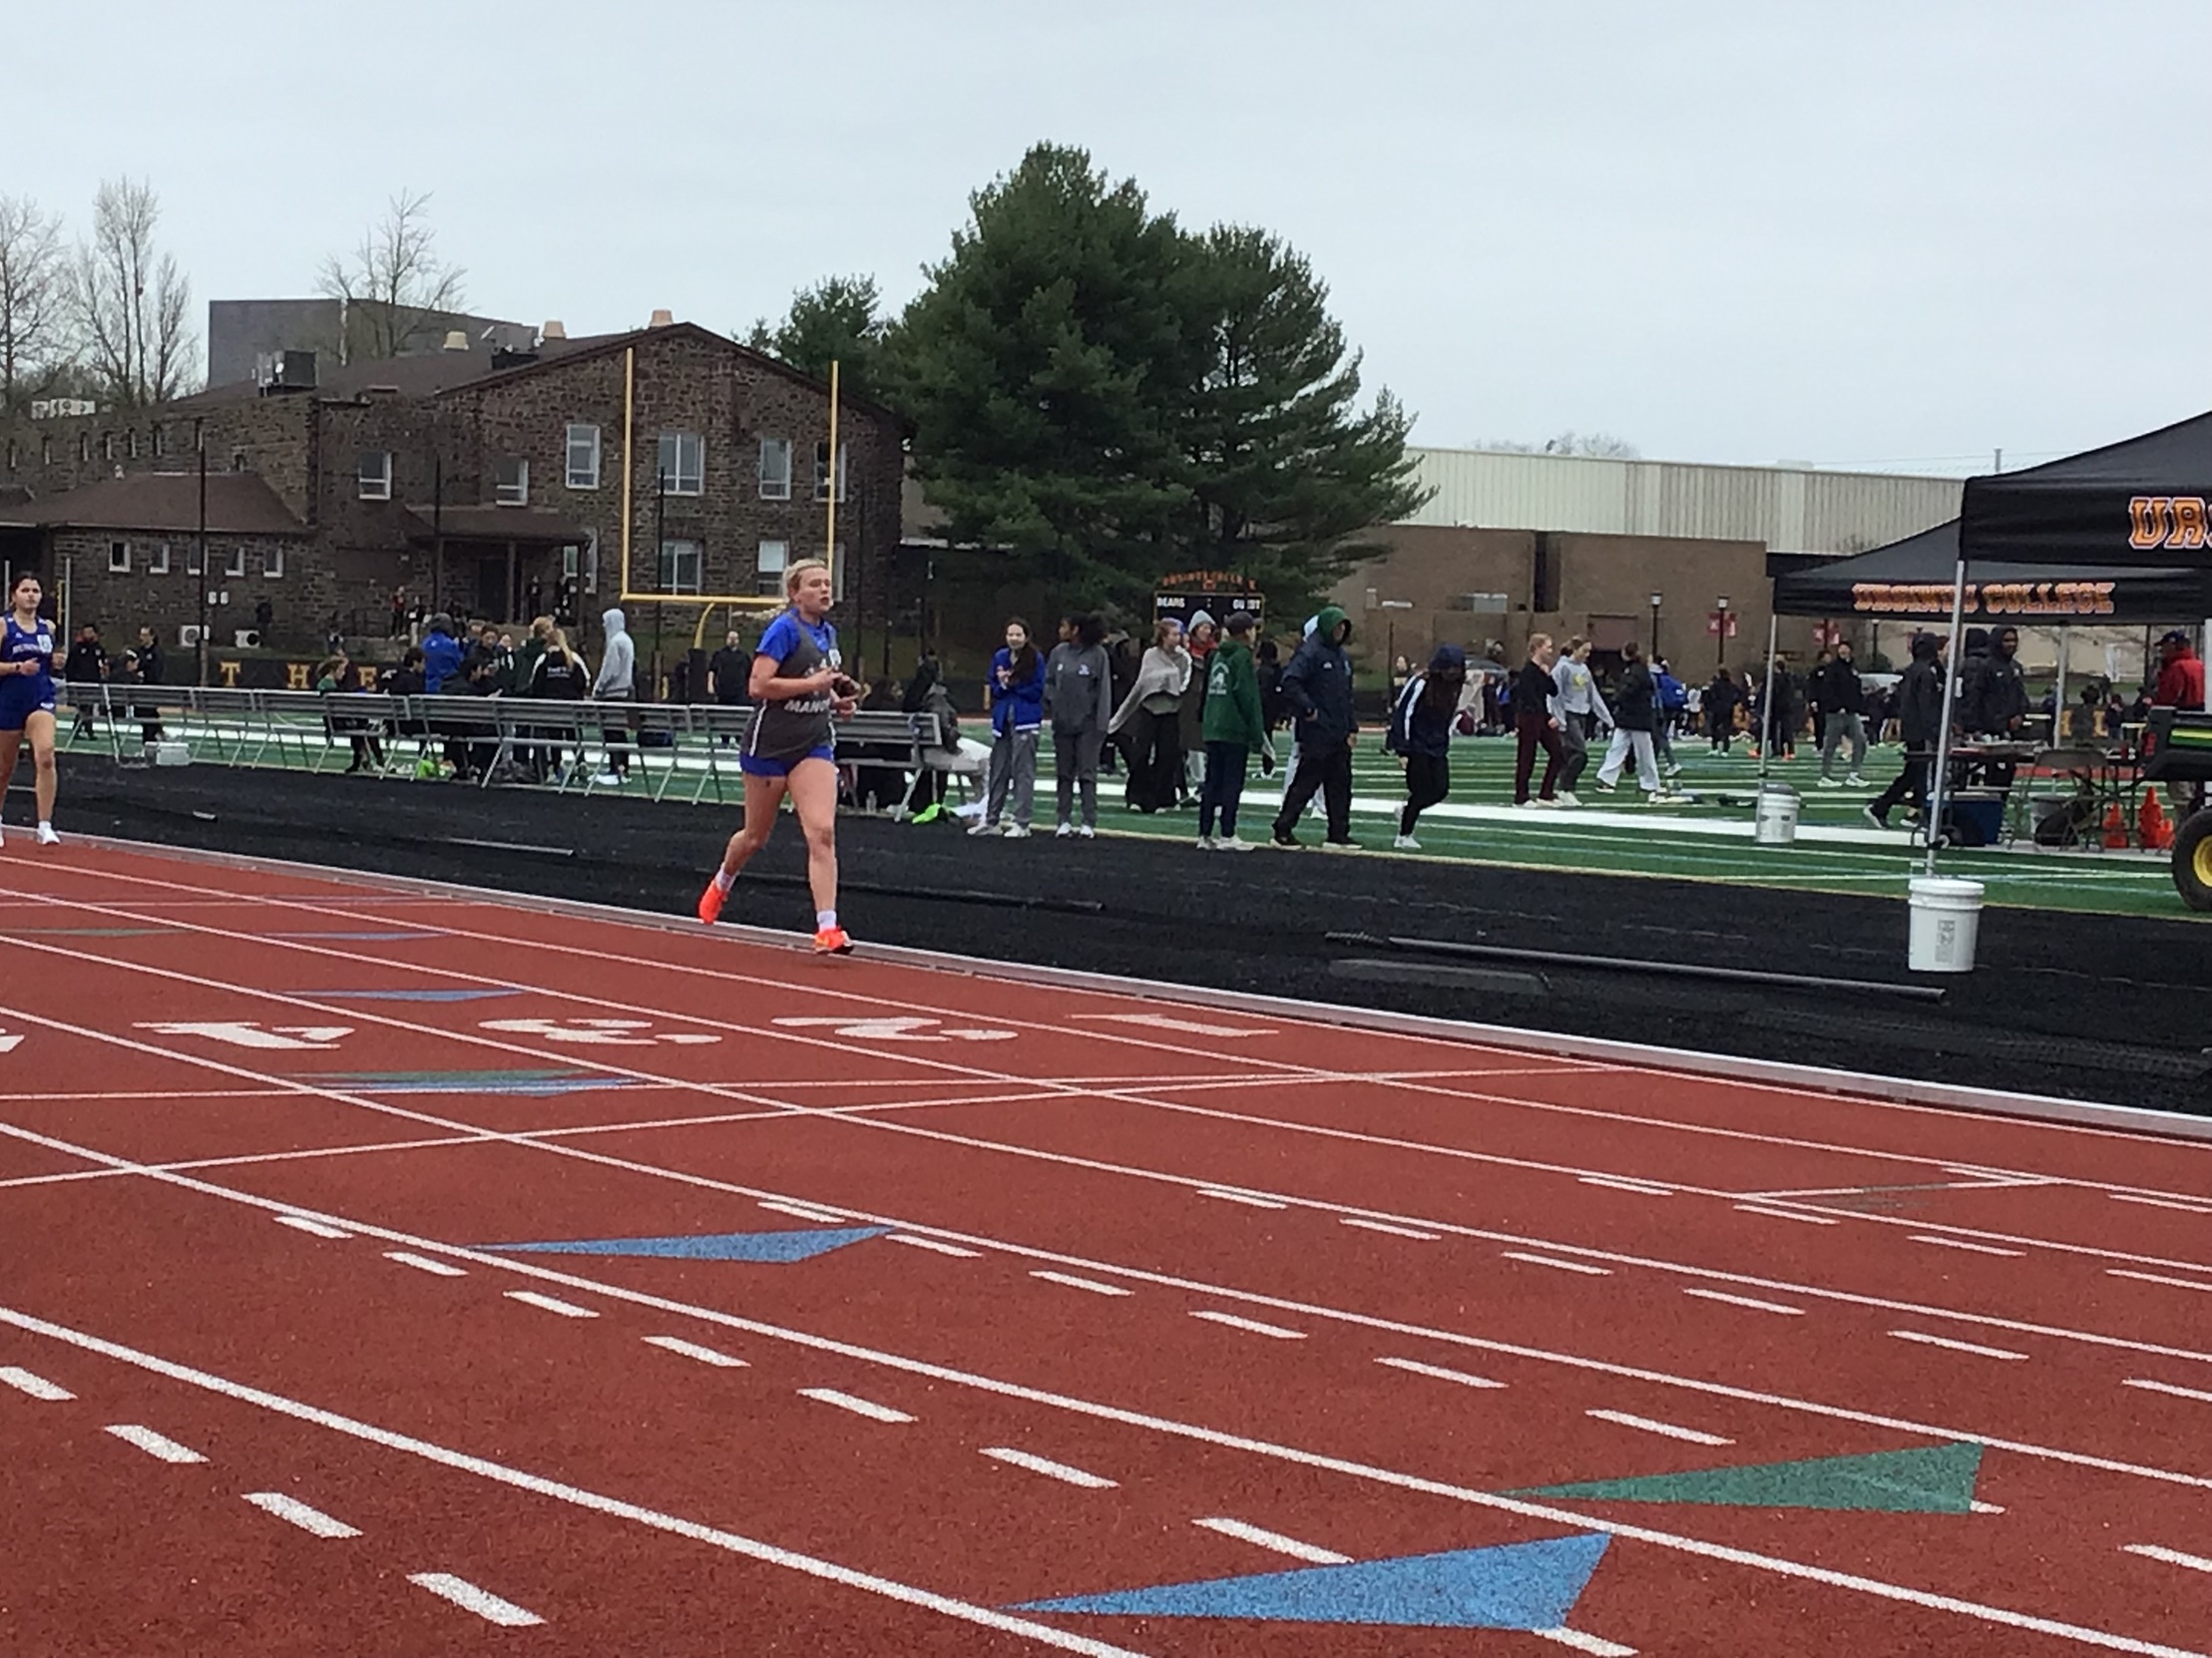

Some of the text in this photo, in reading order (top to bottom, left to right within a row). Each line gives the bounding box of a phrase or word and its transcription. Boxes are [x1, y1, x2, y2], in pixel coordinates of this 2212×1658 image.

[2128, 496, 2212, 550] UR
[1156, 596, 1185, 609] BEARS
[1982, 582, 2116, 615] COLLEGE
